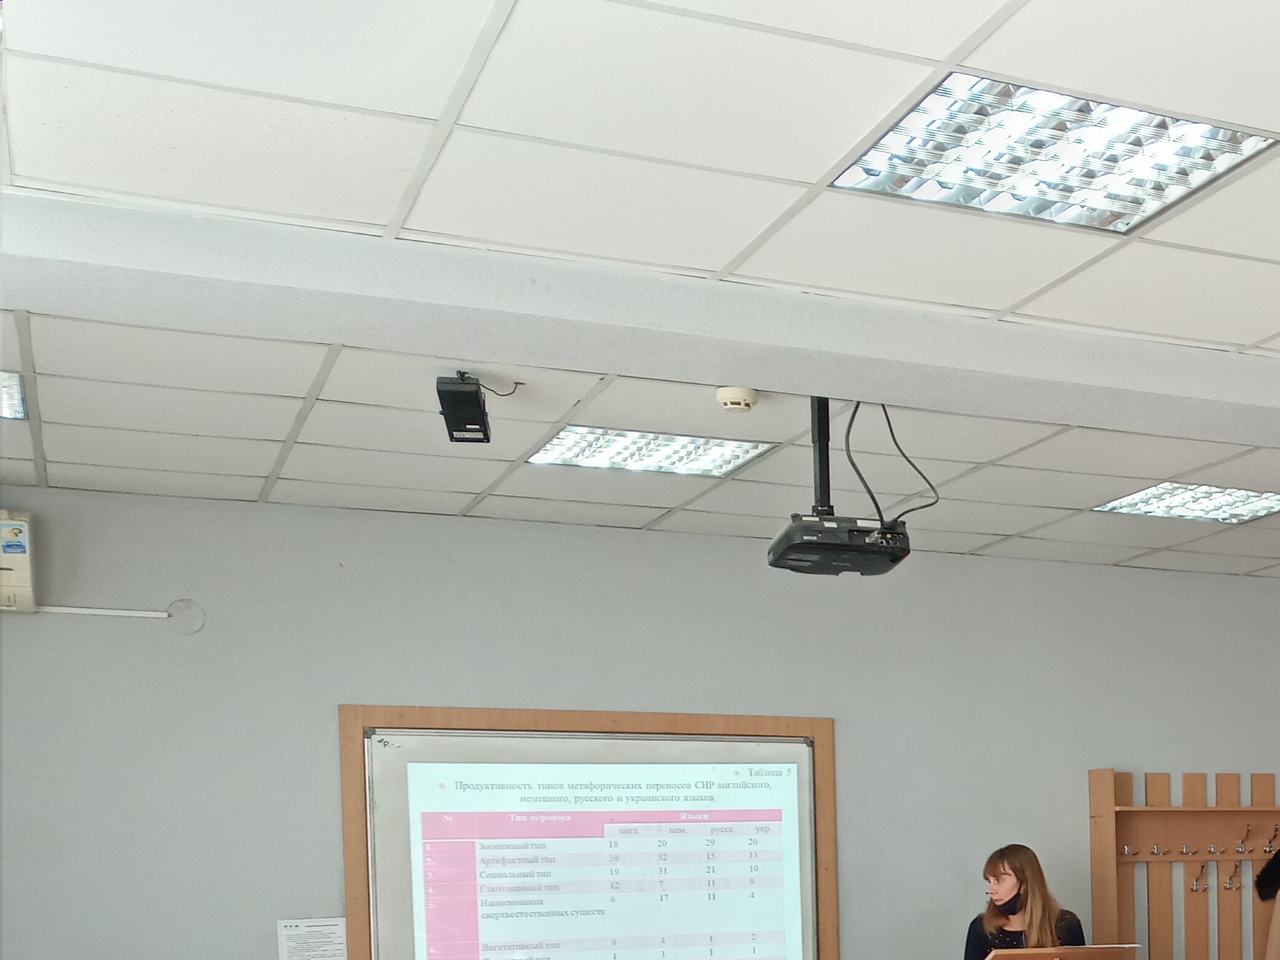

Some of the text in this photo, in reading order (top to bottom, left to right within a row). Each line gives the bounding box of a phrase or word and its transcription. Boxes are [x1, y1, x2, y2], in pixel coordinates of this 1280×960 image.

[748, 768, 792, 776] Таблица 5
[454, 781, 533, 792] Продуктивность
[567, 782, 642, 792] метафорических
[646, 783, 692, 792] переносов
[694, 781, 715, 790] СНР
[717, 780, 772, 790] английского,
[520, 796, 572, 804] немецкого,
[574, 796, 614, 804] русского
[625, 794, 680, 804] украинского
[683, 794, 714, 802] языков
[510, 814, 572, 824] Тип переноса
[680, 812, 709, 820] Языки
[530, 842, 546, 850] тип
[657, 840, 668, 848] 20
[706, 839, 716, 847] 29
[748, 838, 758, 846] 20
[540, 856, 556, 864] тип
[658, 854, 668, 862] 32
[706, 852, 716, 860] 15
[610, 868, 620, 876] 19
[706, 866, 716, 874] 21
[479, 870, 536, 879] Социальный
[543, 884, 559, 892] тип
[610, 882, 620, 890] 12
[660, 894, 669, 902] 17
[480, 900, 544, 908] Наименования
[570, 908, 605, 918] существ
